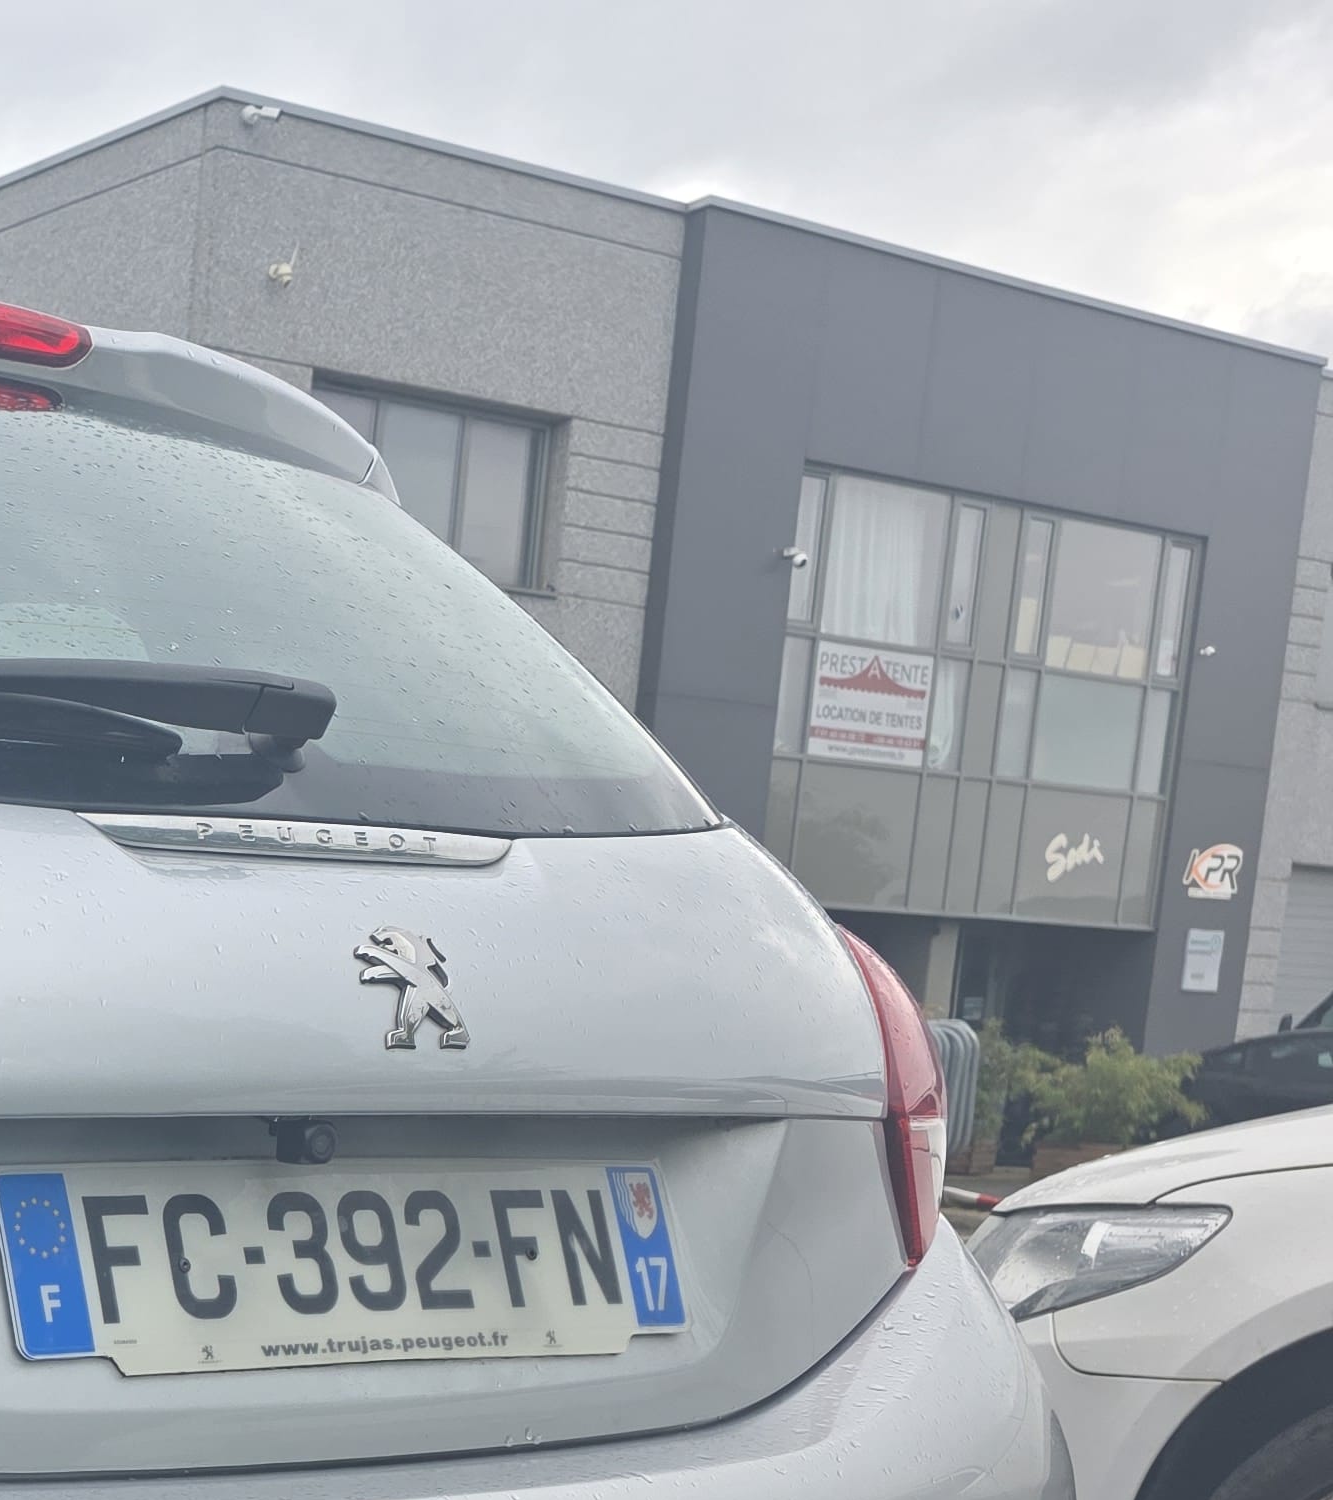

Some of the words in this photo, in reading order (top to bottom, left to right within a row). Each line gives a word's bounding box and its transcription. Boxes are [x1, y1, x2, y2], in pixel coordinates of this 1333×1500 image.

[815, 703, 868, 724] LOCATION
[868, 710, 885, 727] DE
[885, 711, 924, 731] TENTES
[195, 821, 437, 853] PEUGEOT
[81, 1188, 624, 1325] FC-392-FN
[634, 1256, 668, 1312] 17
[39, 1284, 62, 1324] F
[260, 1331, 510, 1359] www.trujas.peugeot.fr
